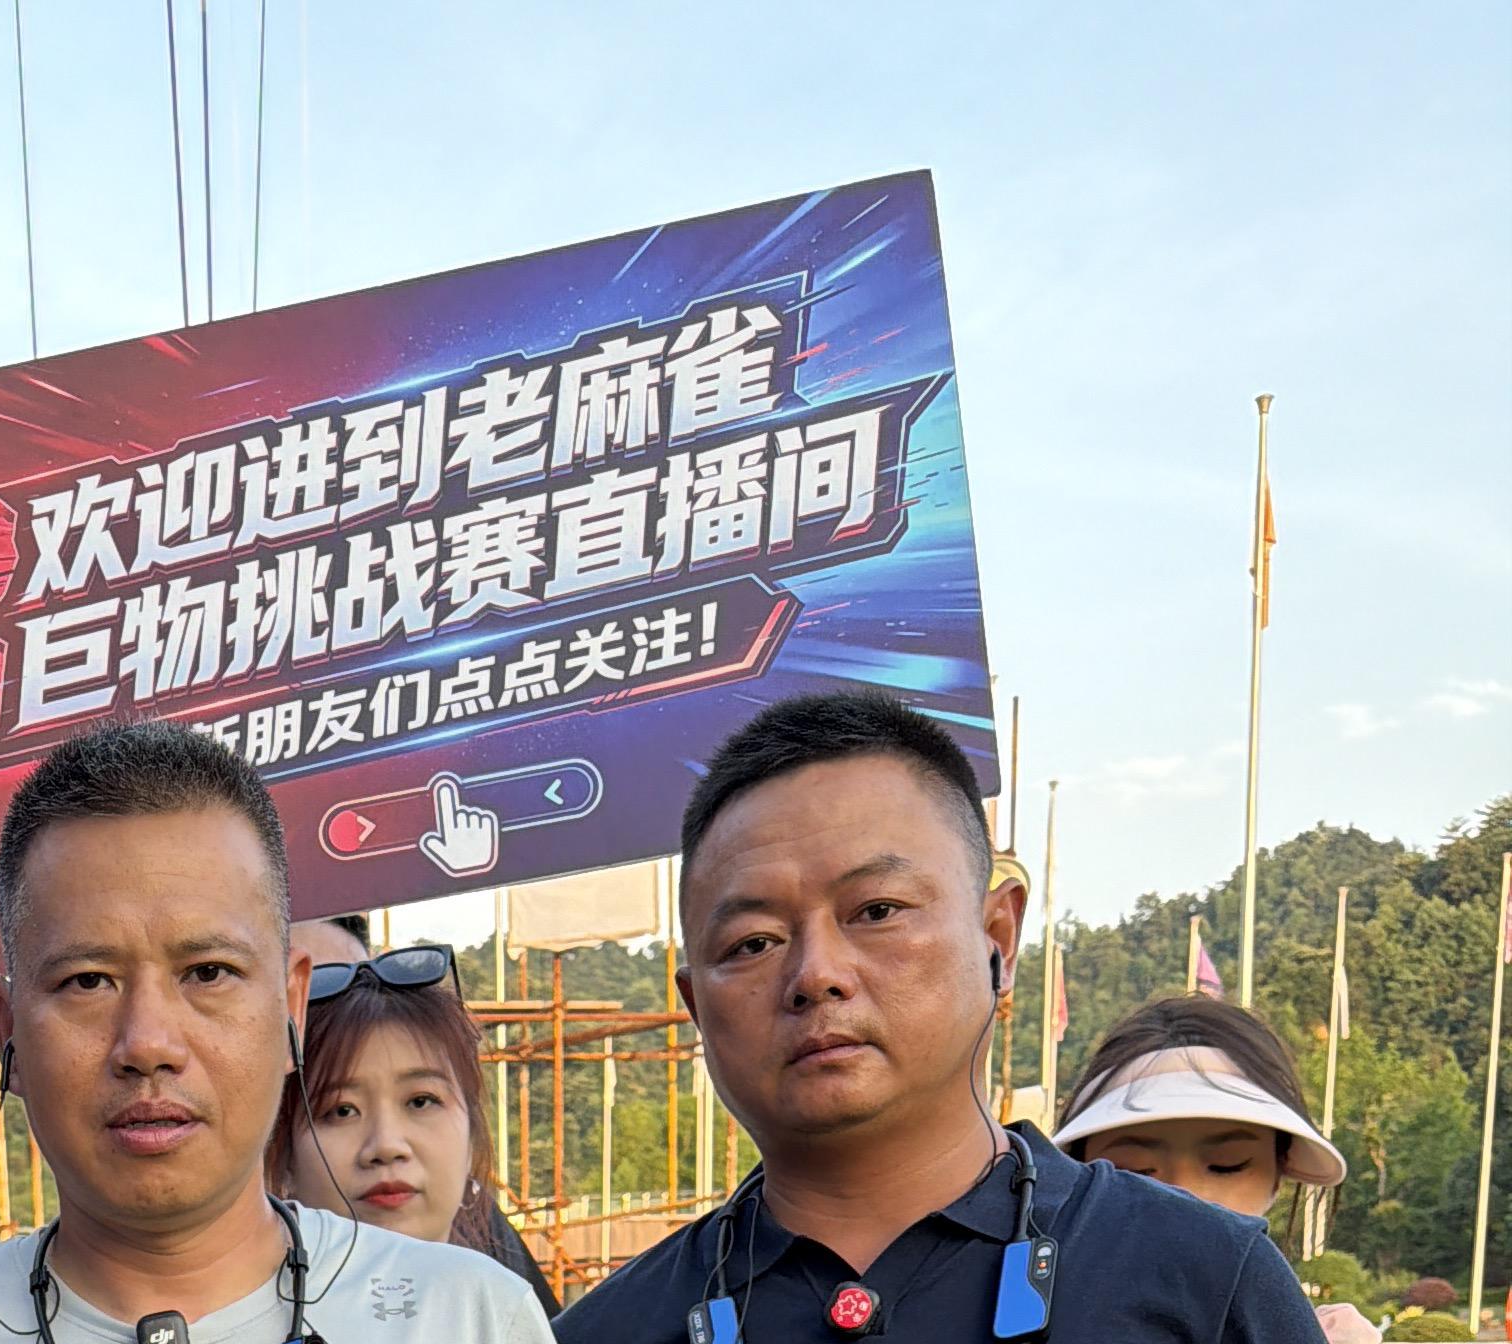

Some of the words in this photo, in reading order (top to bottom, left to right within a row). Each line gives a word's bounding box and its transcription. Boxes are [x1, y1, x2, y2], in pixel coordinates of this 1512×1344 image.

[9, 407, 887, 734] 巨物挑战赛直播间
[25, 304, 786, 601] 欢迎进到老麻雀
